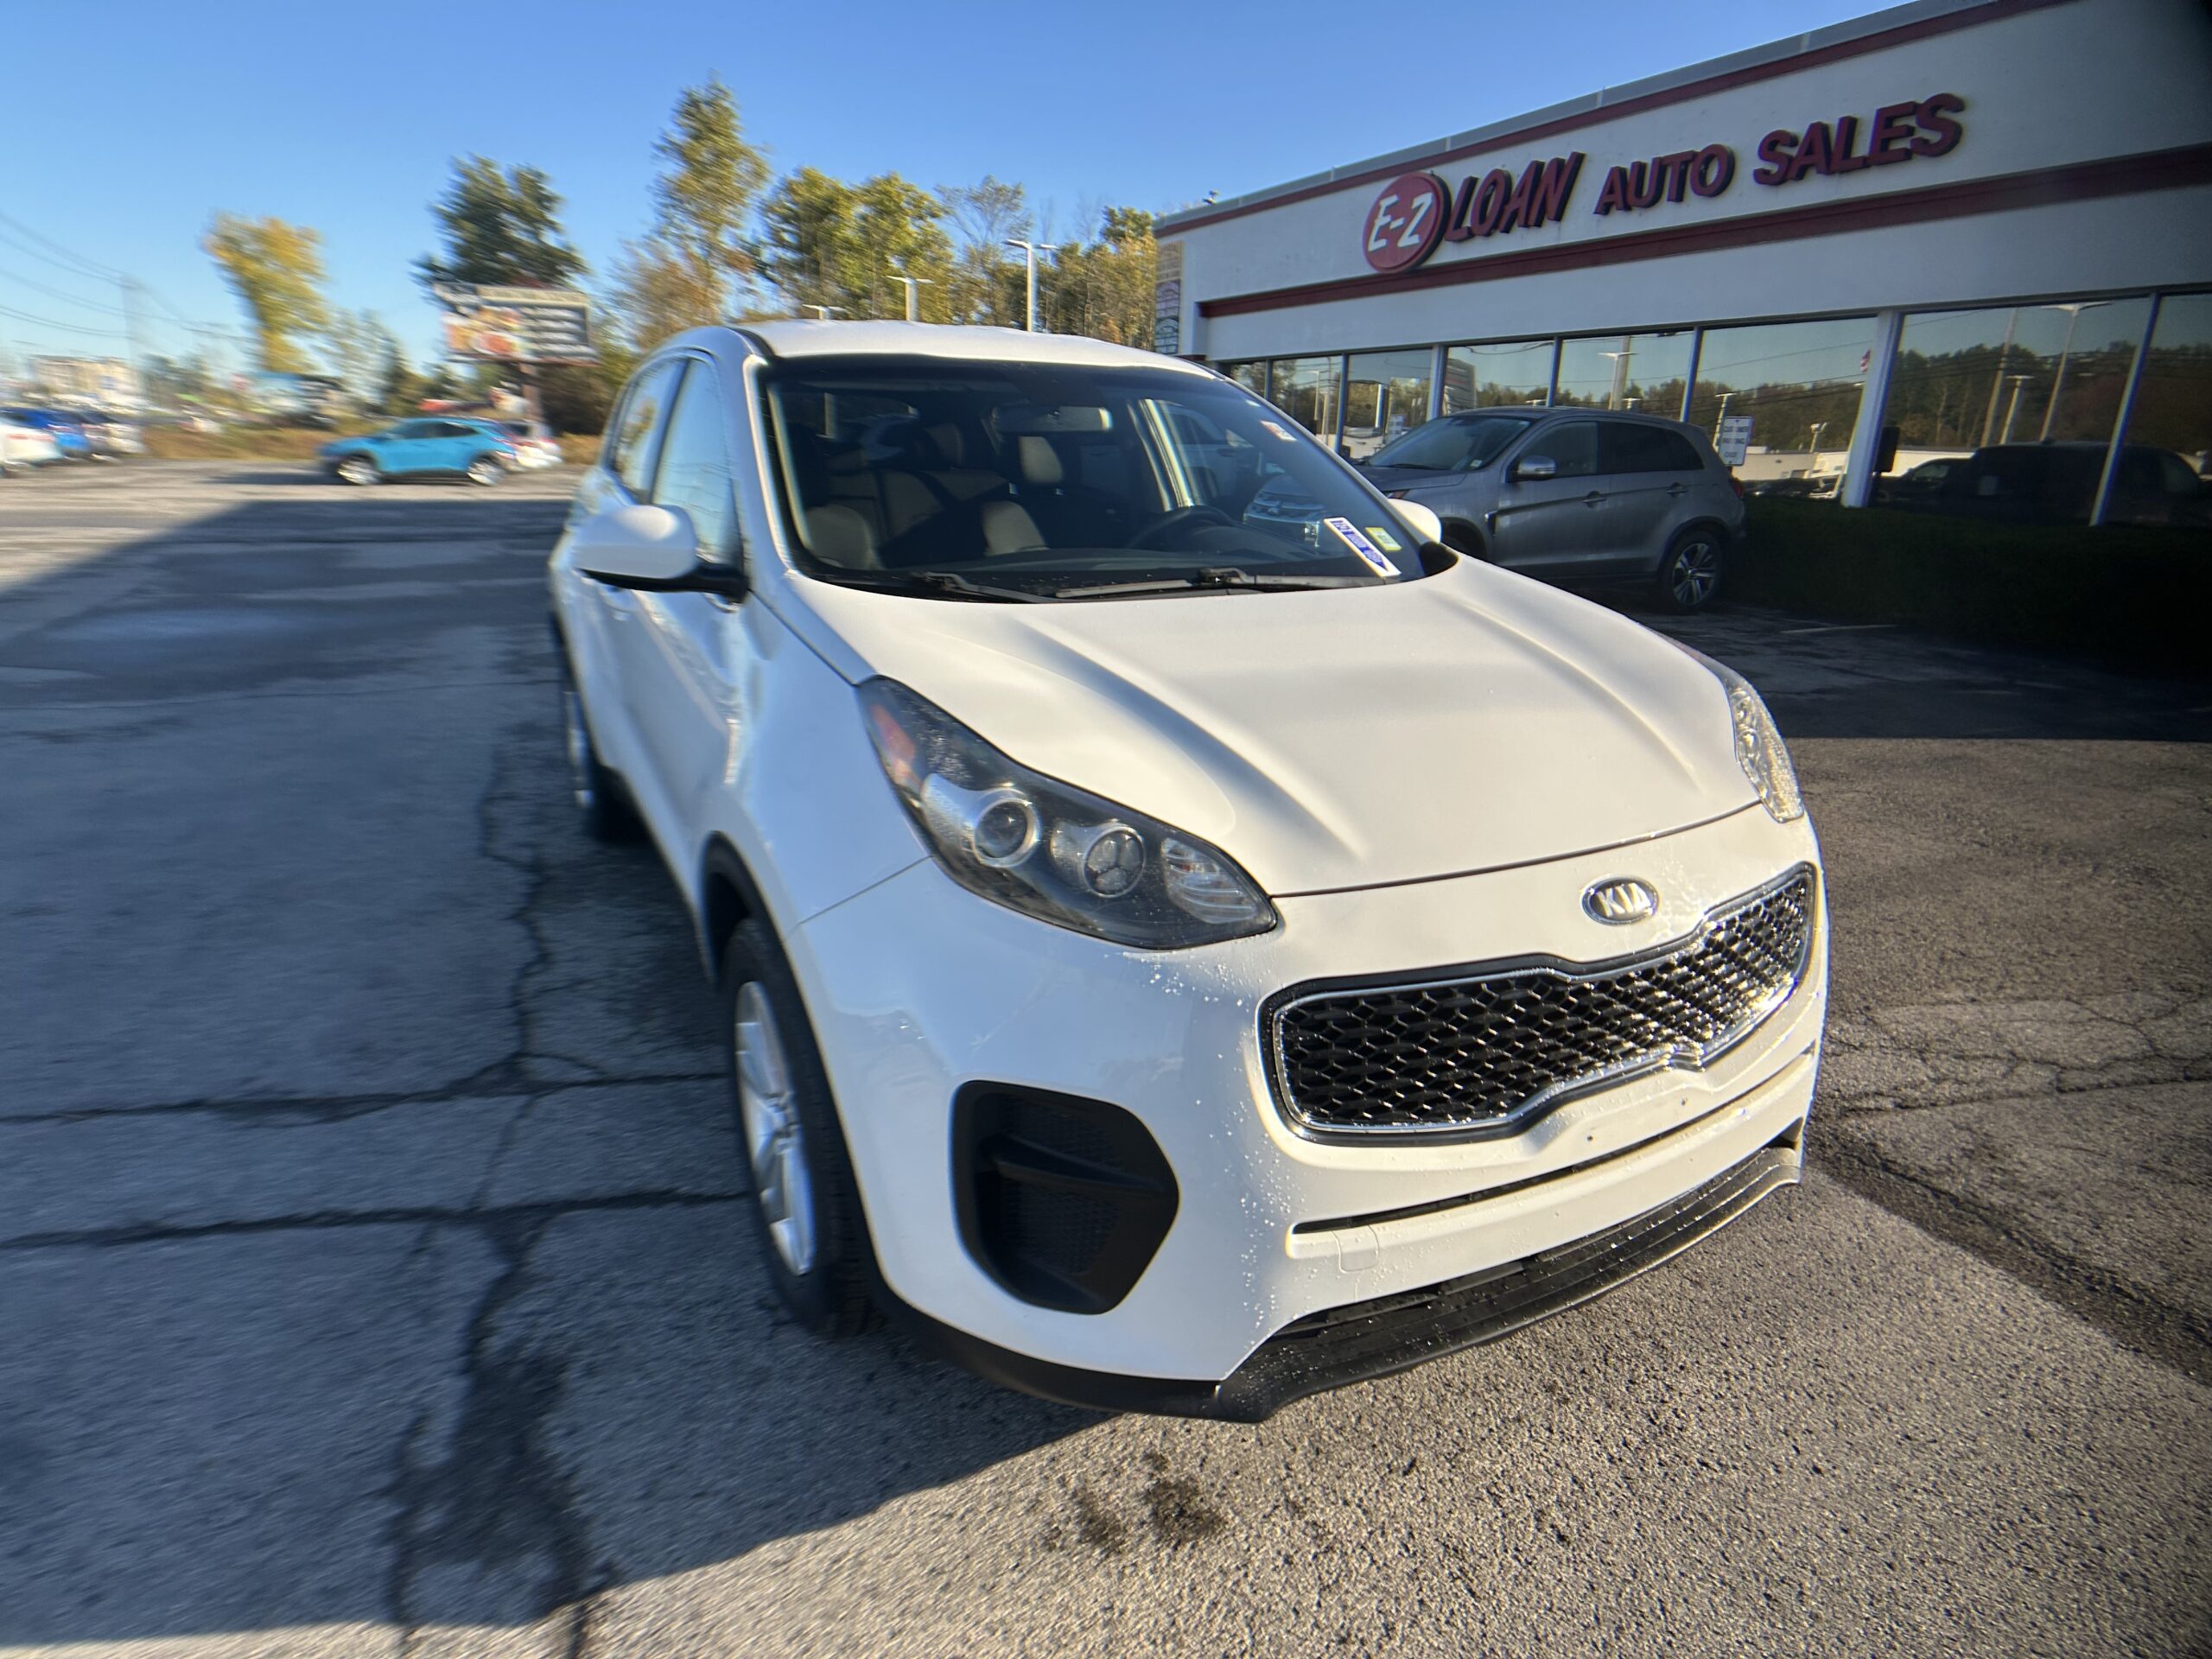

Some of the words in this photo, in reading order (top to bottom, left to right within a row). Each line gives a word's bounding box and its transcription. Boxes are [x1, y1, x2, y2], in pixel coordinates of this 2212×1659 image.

[1369, 192, 1434, 252] E-Z
[1445, 151, 1586, 242] LOAN
[1593, 143, 1736, 216] AUTO
[1753, 92, 1966, 186] SALES
[1598, 882, 1651, 918] KIA
